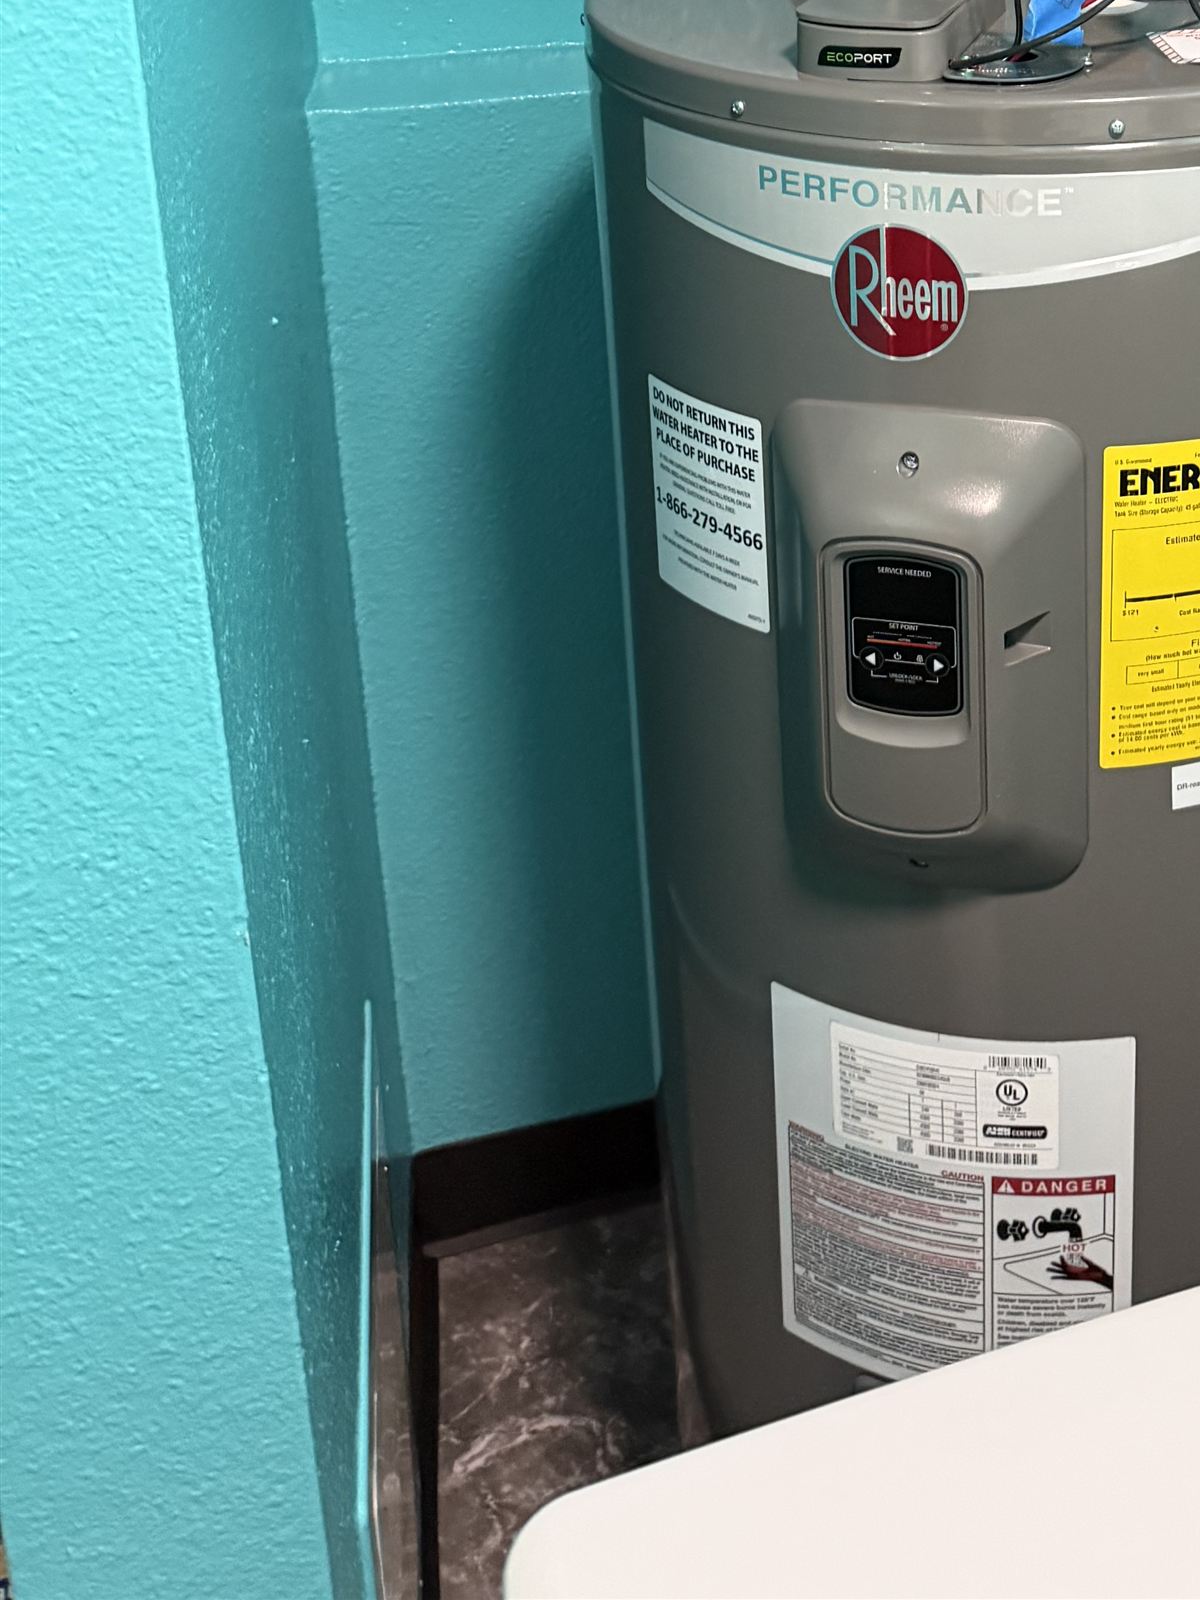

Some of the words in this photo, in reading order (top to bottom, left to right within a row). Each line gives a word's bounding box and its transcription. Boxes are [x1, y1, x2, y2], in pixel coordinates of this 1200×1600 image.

[826, 52, 892, 64] ECOPORT
[758, 165, 1062, 217] PERFORMANCE
[849, 225, 958, 335] Rheem
[653, 387, 665, 403] DO
[666, 395, 684, 414] NOT
[686, 405, 726, 432] RETURN
[728, 421, 755, 440] THIS
[652, 404, 679, 431] WATER
[680, 421, 718, 449] HEATER
[719, 436, 734, 454] TO
[735, 444, 759, 463] THE
[656, 427, 682, 453] PLACE
[683, 443, 695, 459] OF
[697, 450, 755, 482] PURCHASE
[657, 486, 763, 550] 1-866-279-4566
[877, 566, 903, 575] SERVICE
[905, 568, 931, 578] NEEDED
[1003, 1084, 1020, 1101] UL
[941, 1169, 984, 1181] CAUTION
[1021, 1179, 1107, 1193] DANGER
[1062, 1244, 1086, 1252] HOT
